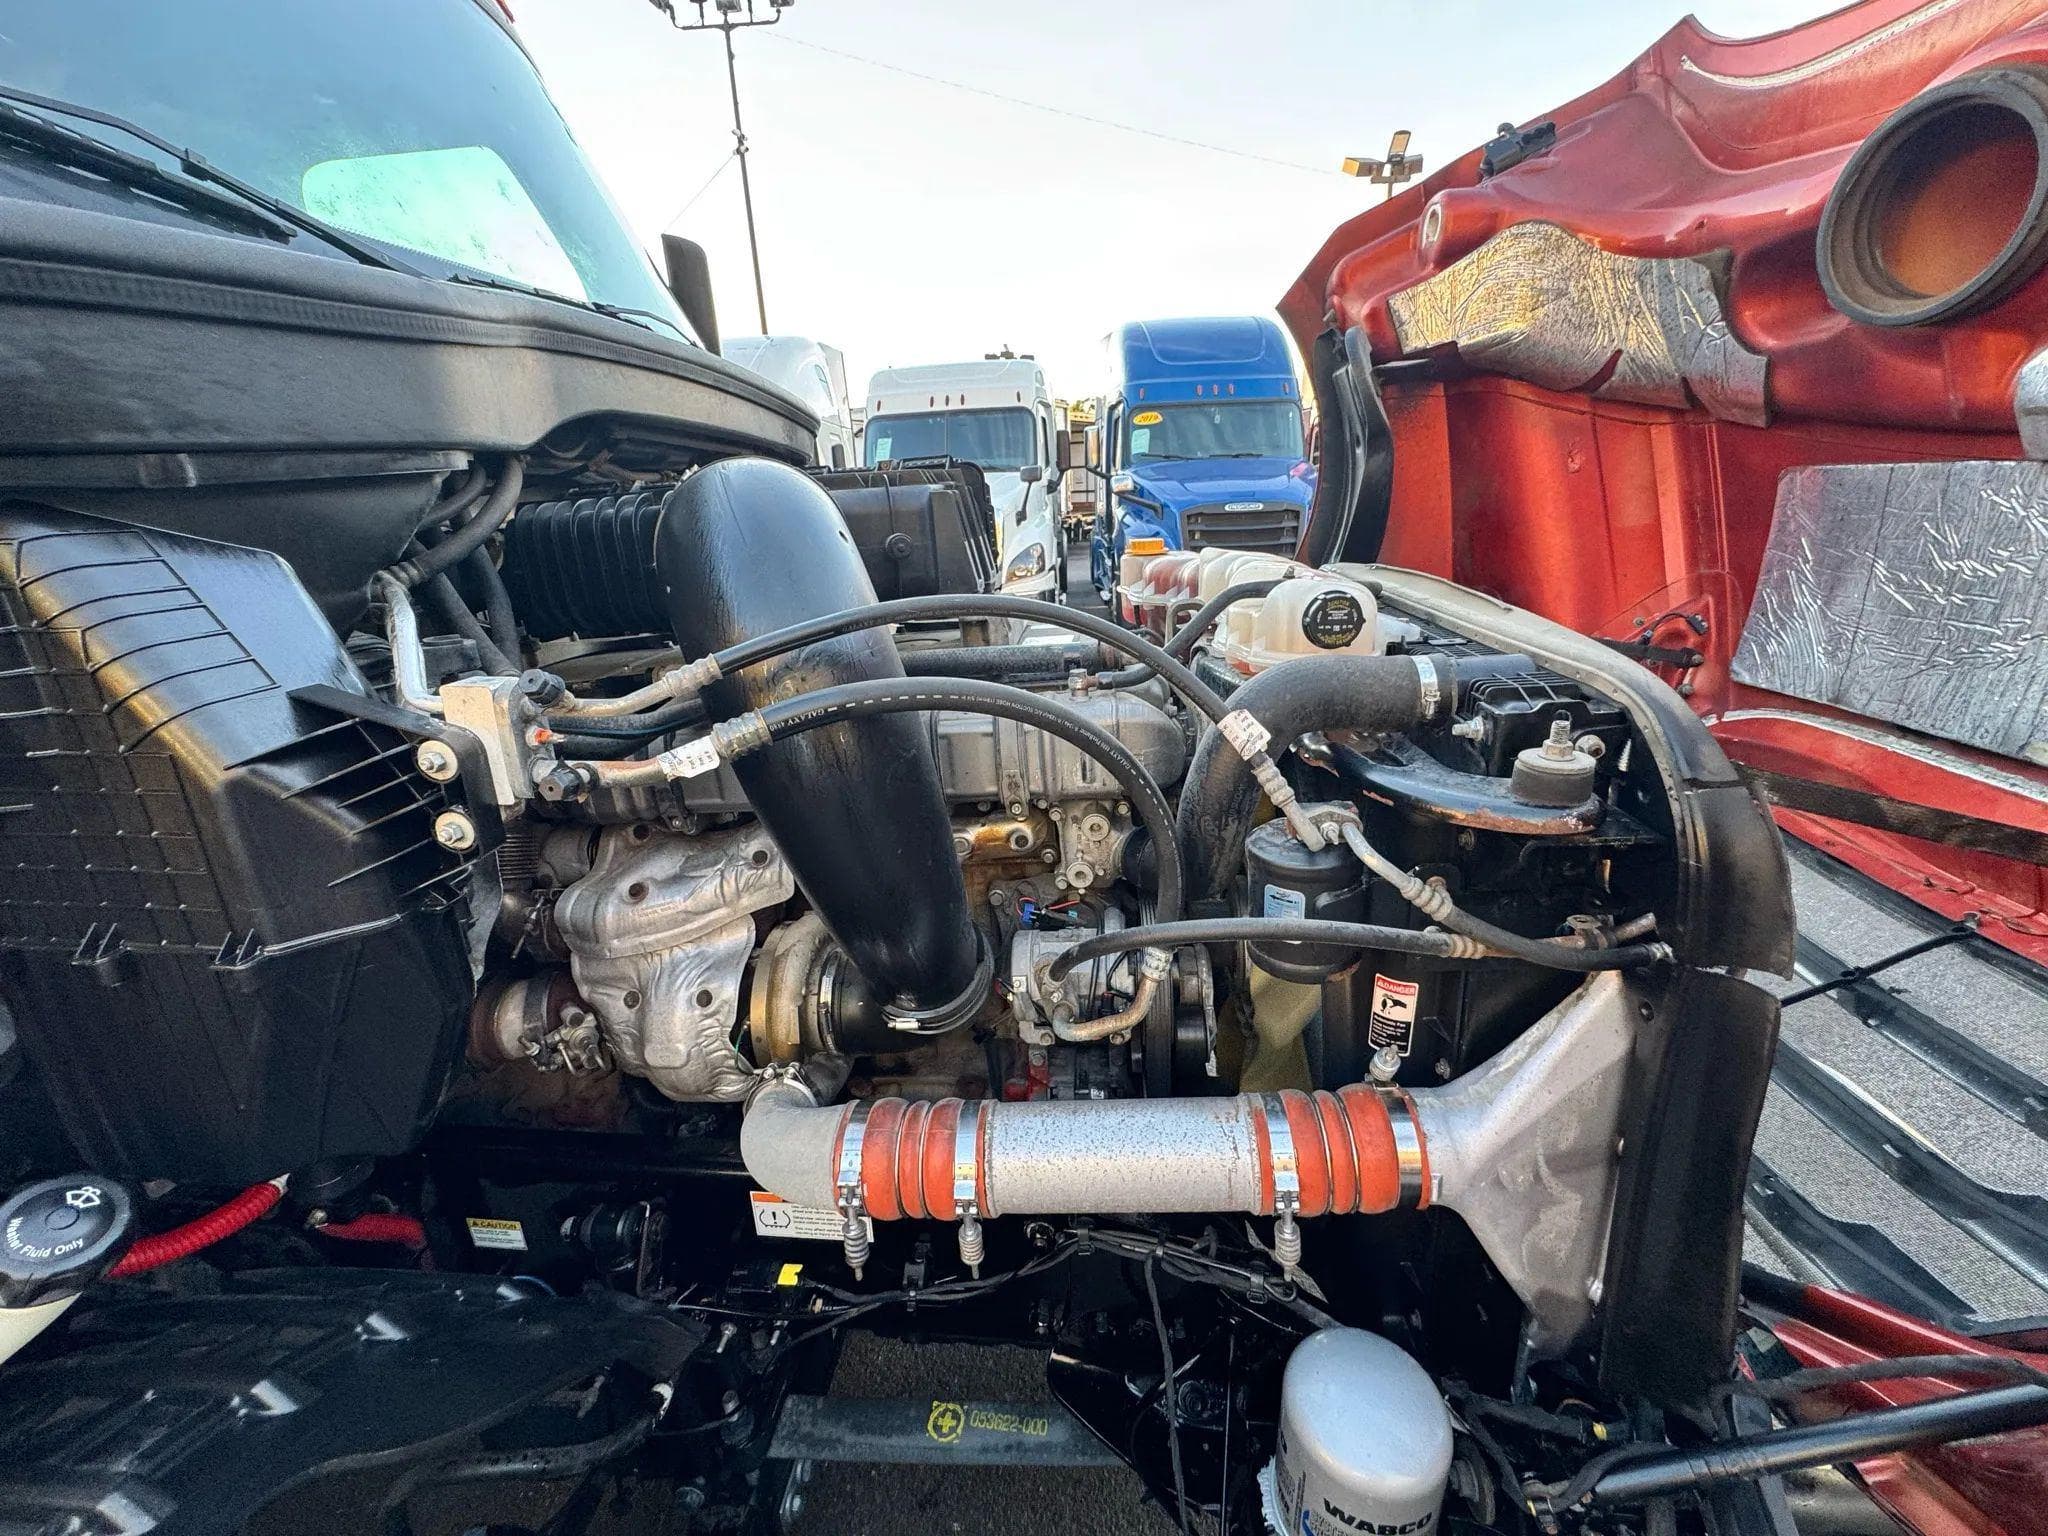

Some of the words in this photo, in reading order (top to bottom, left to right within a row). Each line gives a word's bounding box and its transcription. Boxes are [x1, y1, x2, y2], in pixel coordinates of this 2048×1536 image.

[787, 708, 825, 725] GALAXY
[1108, 749, 1131, 770] GALAXY
[1384, 983, 1415, 994] DANGER
[480, 1220, 518, 1229] CAUTION
[7, 1217, 23, 1250] Washer
[20, 1245, 52, 1257] Fluid
[54, 1238, 84, 1255] Only
[970, 1410, 1048, 1436] 053622-000
[1323, 1497, 1432, 1536] WABCO
